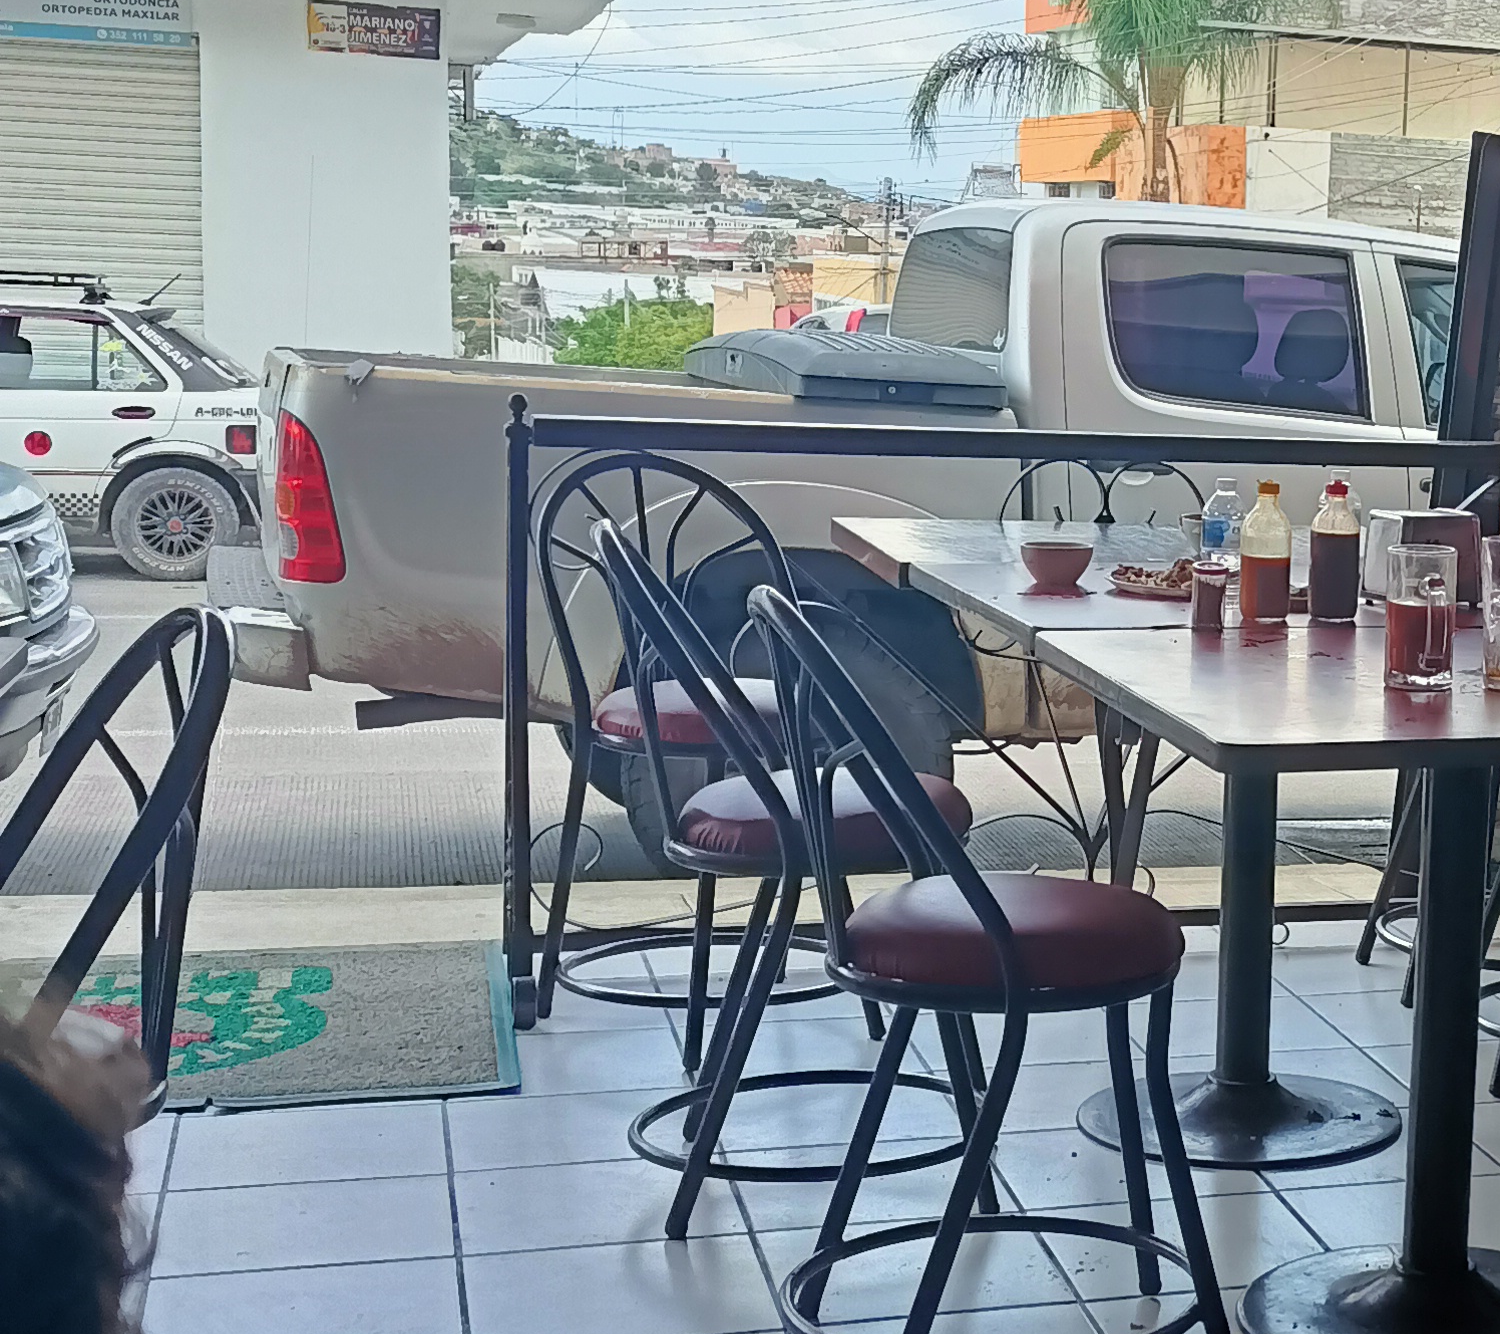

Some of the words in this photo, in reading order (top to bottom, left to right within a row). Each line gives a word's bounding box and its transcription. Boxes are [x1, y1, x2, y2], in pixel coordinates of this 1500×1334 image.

[41, 3, 118, 18] ORTOPEDIA
[121, 8, 180, 21] MAXILAR
[349, 14, 415, 31] MARIANO
[131, 31, 147, 42] 111
[348, 32, 407, 46] JIMENEZ
[136, 323, 194, 371] NISSAN
